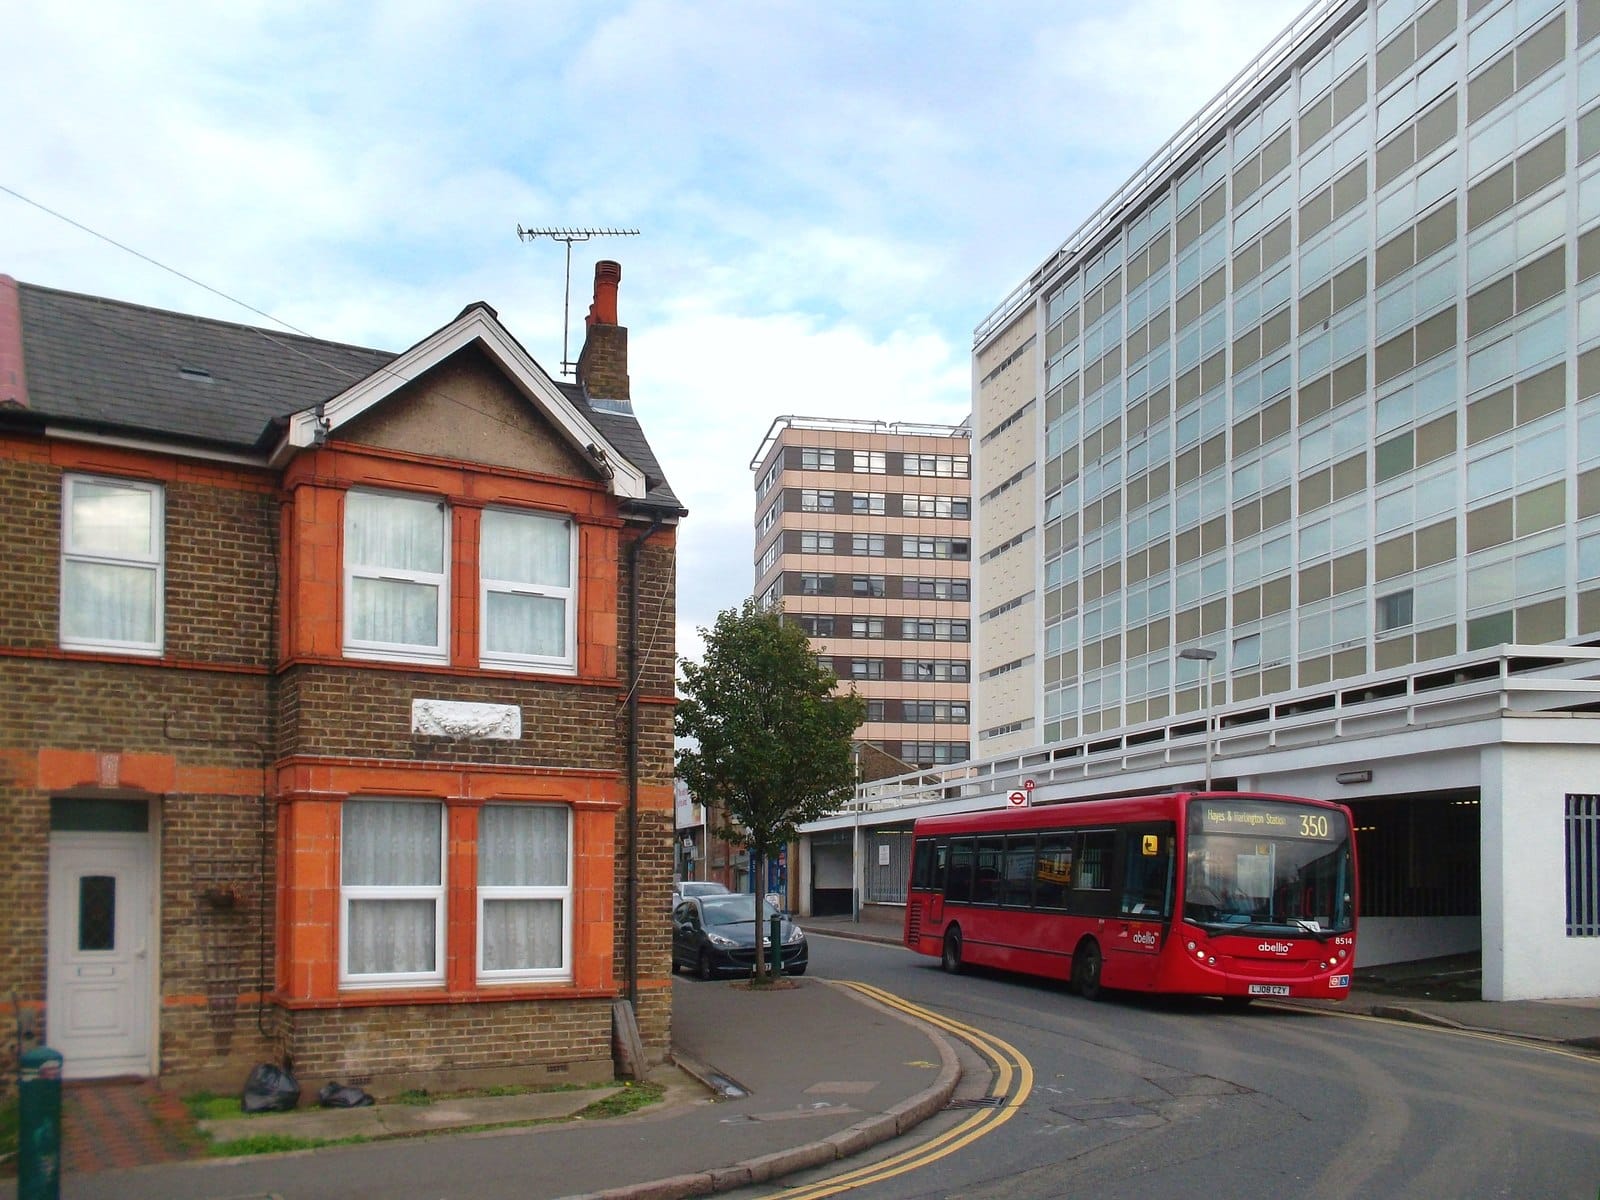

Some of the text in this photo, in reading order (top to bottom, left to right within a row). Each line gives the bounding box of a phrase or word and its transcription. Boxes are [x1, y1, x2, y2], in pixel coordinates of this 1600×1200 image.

[1208, 809, 1225, 824] Hayes
[1227, 811, 1233, 822] &
[1265, 813, 1287, 825] Station
[1299, 815, 1328, 837] 350
[1133, 931, 1155, 944] abellio
[1335, 937, 1352, 945] 8514
[1258, 941, 1289, 952] abellio
[1272, 986, 1287, 994] CZY
